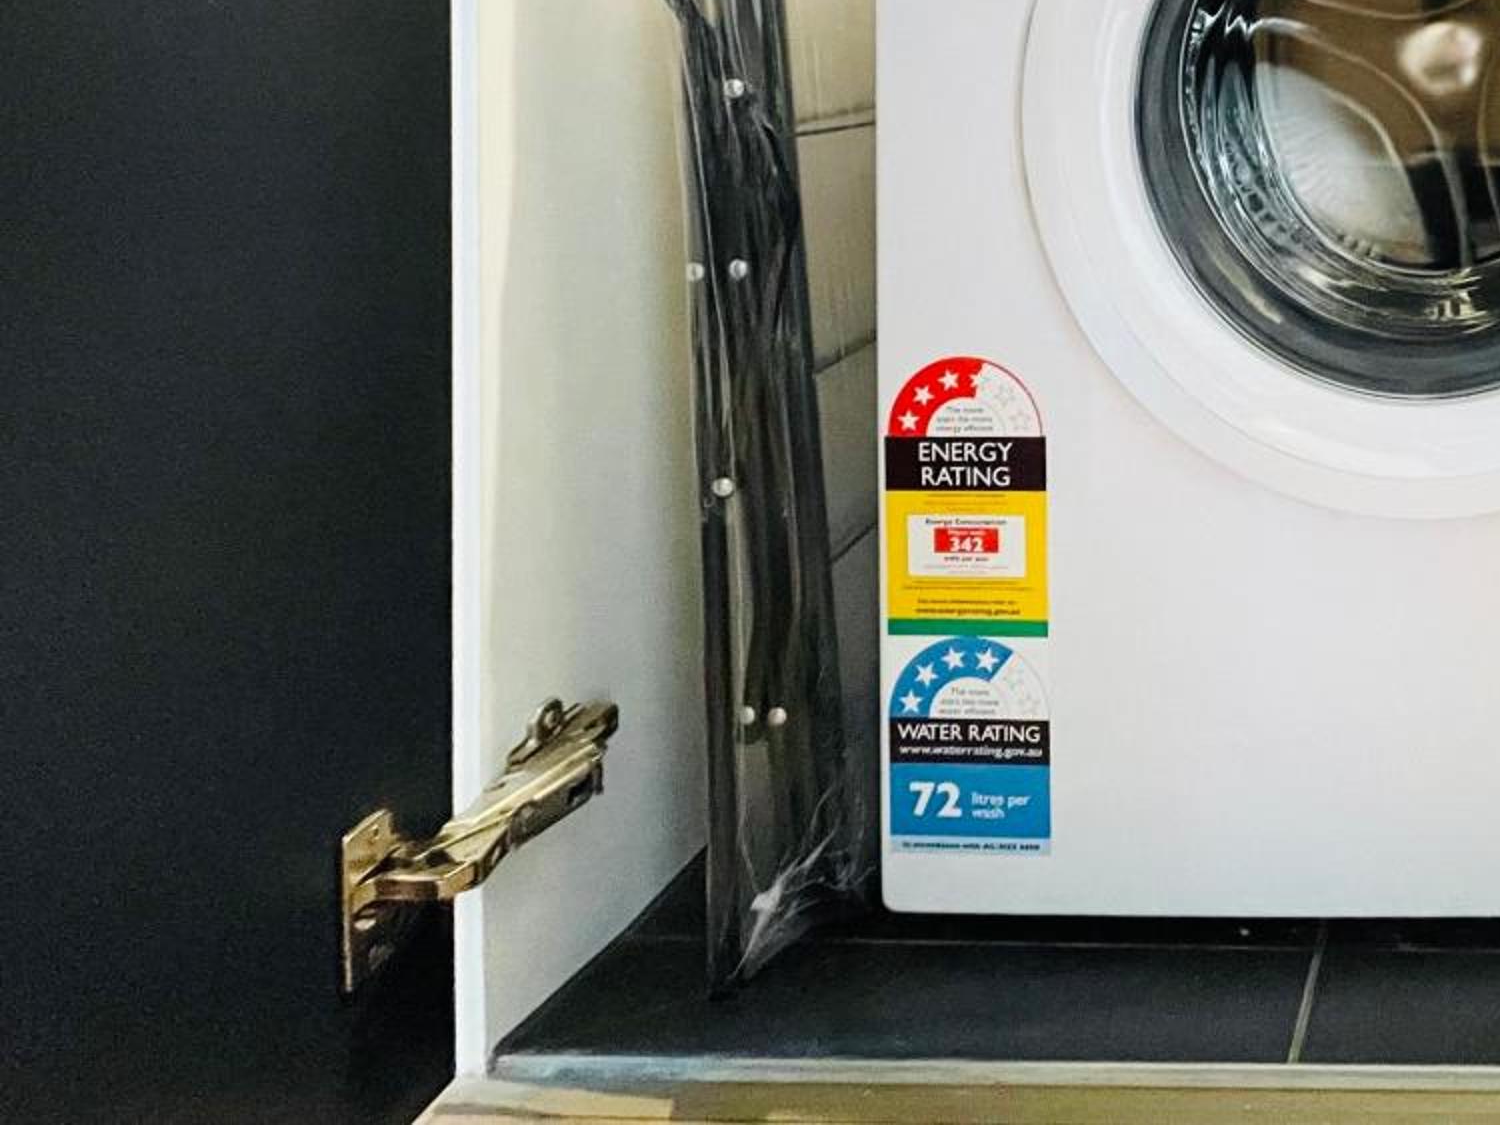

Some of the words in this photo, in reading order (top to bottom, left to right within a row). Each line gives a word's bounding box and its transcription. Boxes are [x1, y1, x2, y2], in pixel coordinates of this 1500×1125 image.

[918, 442, 1012, 462] ENERGY
[921, 466, 1011, 486] RATING
[949, 537, 985, 552] 342
[898, 723, 963, 741] WATER
[968, 724, 1041, 743] RATING
[899, 745, 1043, 759] www.waterrating.gov.au
[909, 781, 963, 818] 72
[970, 791, 1005, 806] litres
[1007, 794, 1031, 809] per
[971, 808, 1005, 820] wash
